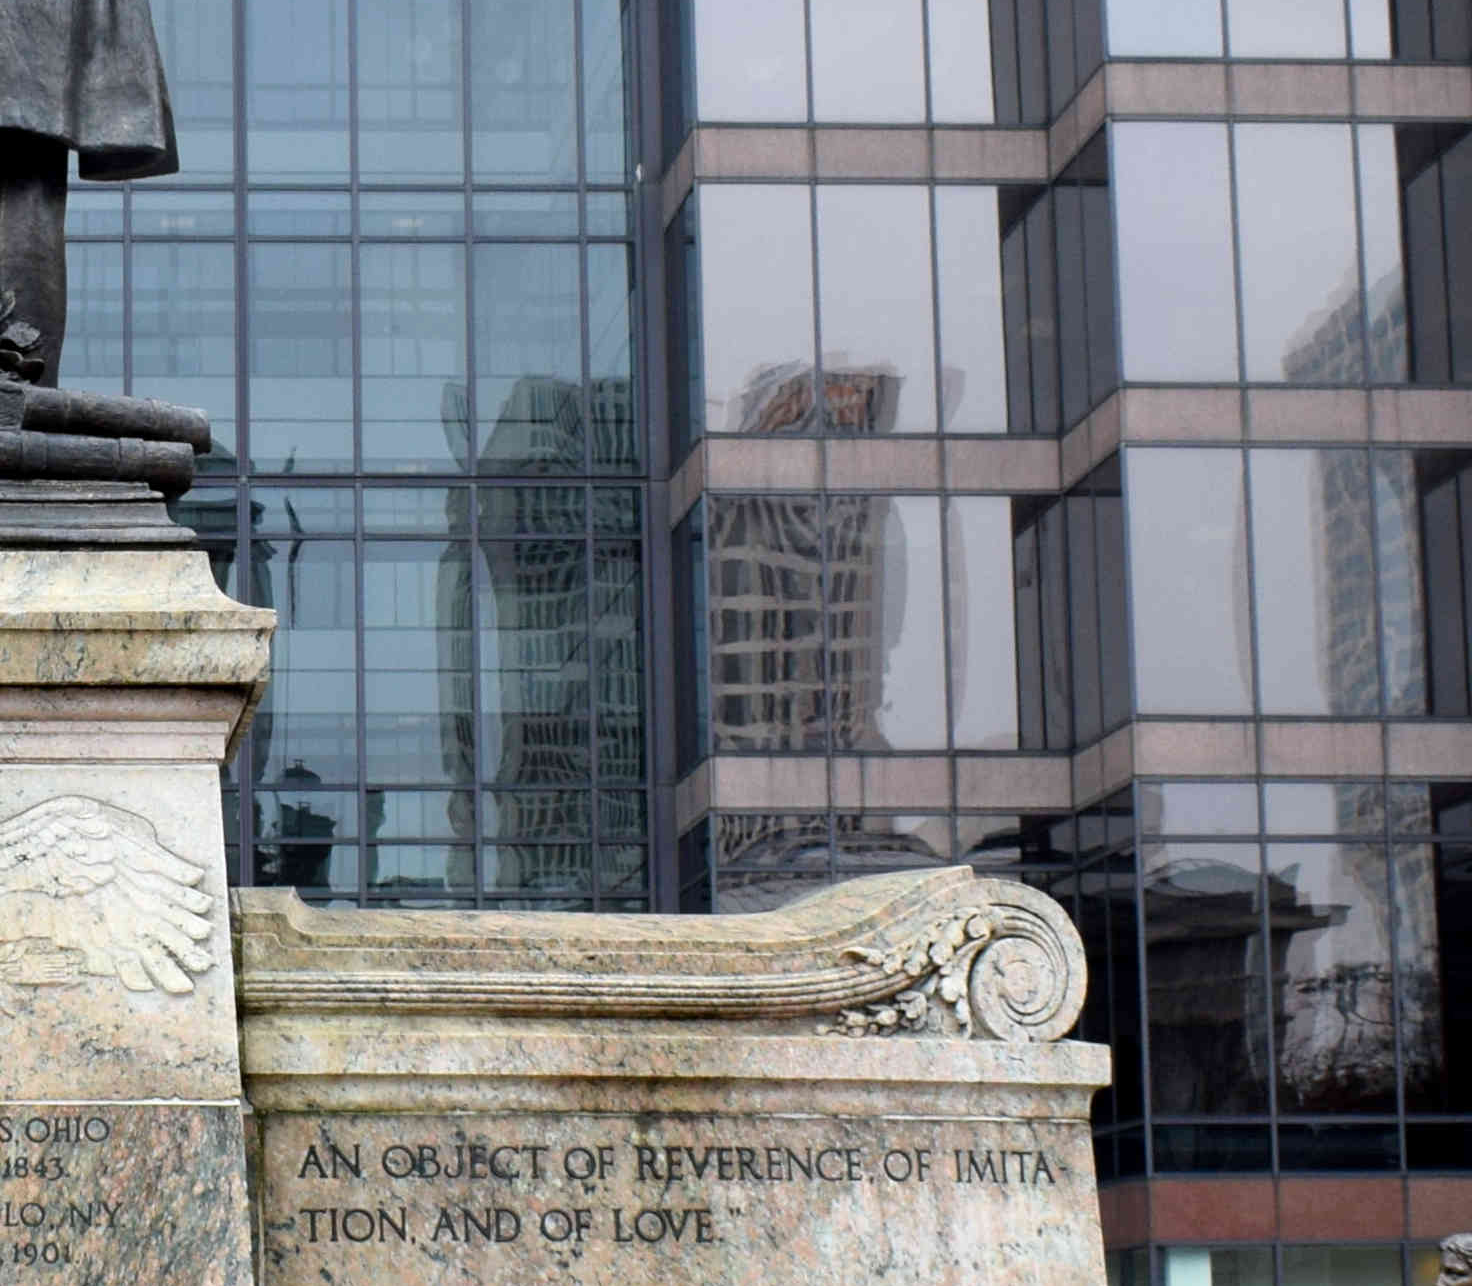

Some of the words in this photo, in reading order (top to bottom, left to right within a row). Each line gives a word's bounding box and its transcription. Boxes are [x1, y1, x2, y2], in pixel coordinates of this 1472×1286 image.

[25, 1117, 110, 1143] OHIO
[298, 1144, 361, 1179] AN
[382, 1145, 549, 1180] OBJECT
[563, 1146, 615, 1180] OF
[634, 1145, 874, 1183] REVERENCE,
[883, 1149, 931, 1182] OF
[954, 1149, 1067, 1184] IMITA-
[432, 1207, 521, 1242] AND
[540, 1208, 593, 1242] OF
